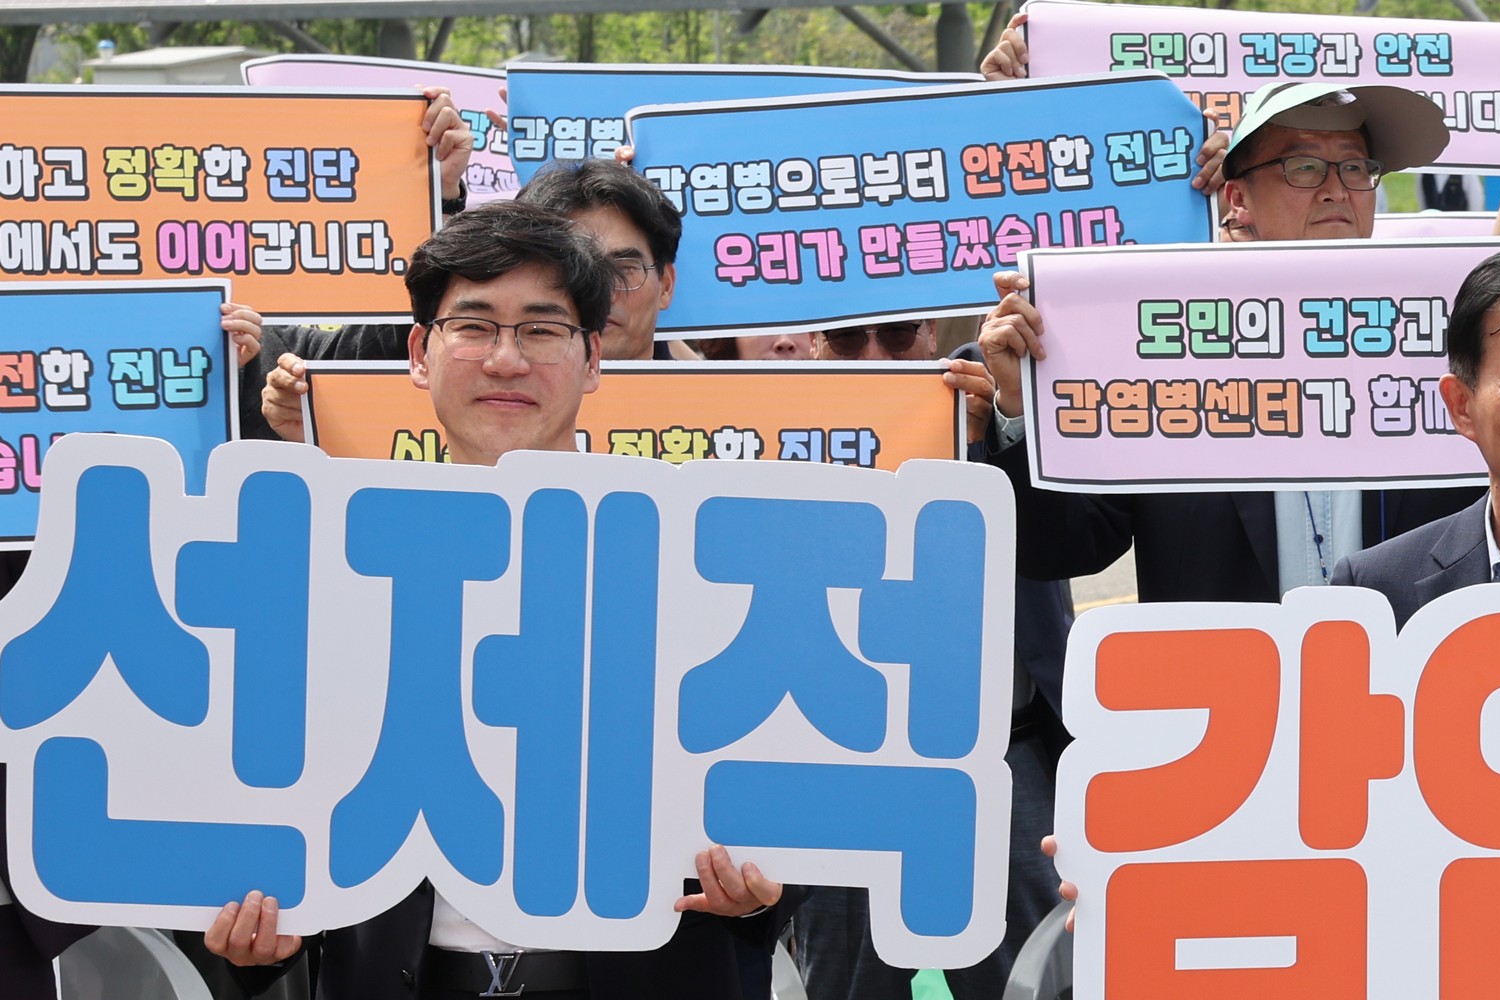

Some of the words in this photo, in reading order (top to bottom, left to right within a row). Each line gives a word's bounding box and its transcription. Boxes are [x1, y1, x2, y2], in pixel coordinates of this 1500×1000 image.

[1110, 32, 1228, 77] 도민의
[1239, 32, 1360, 77] 건강과
[1374, 32, 1453, 77] 안전
[103, 143, 249, 202] 정확한
[265, 146, 359, 202] 진단
[960, 135, 1094, 200] 안전한
[1104, 127, 1194, 186] 전남
[156, 218, 408, 276] 이어갑니다.
[714, 225, 847, 287] 우리가
[1136, 297, 1285, 359] 도민의
[1300, 296, 1449, 358] 건강과
[107, 346, 212, 411] 전남
[1053, 377, 1355, 439] 감염병센터가
[0, 464, 987, 937] 선제적
